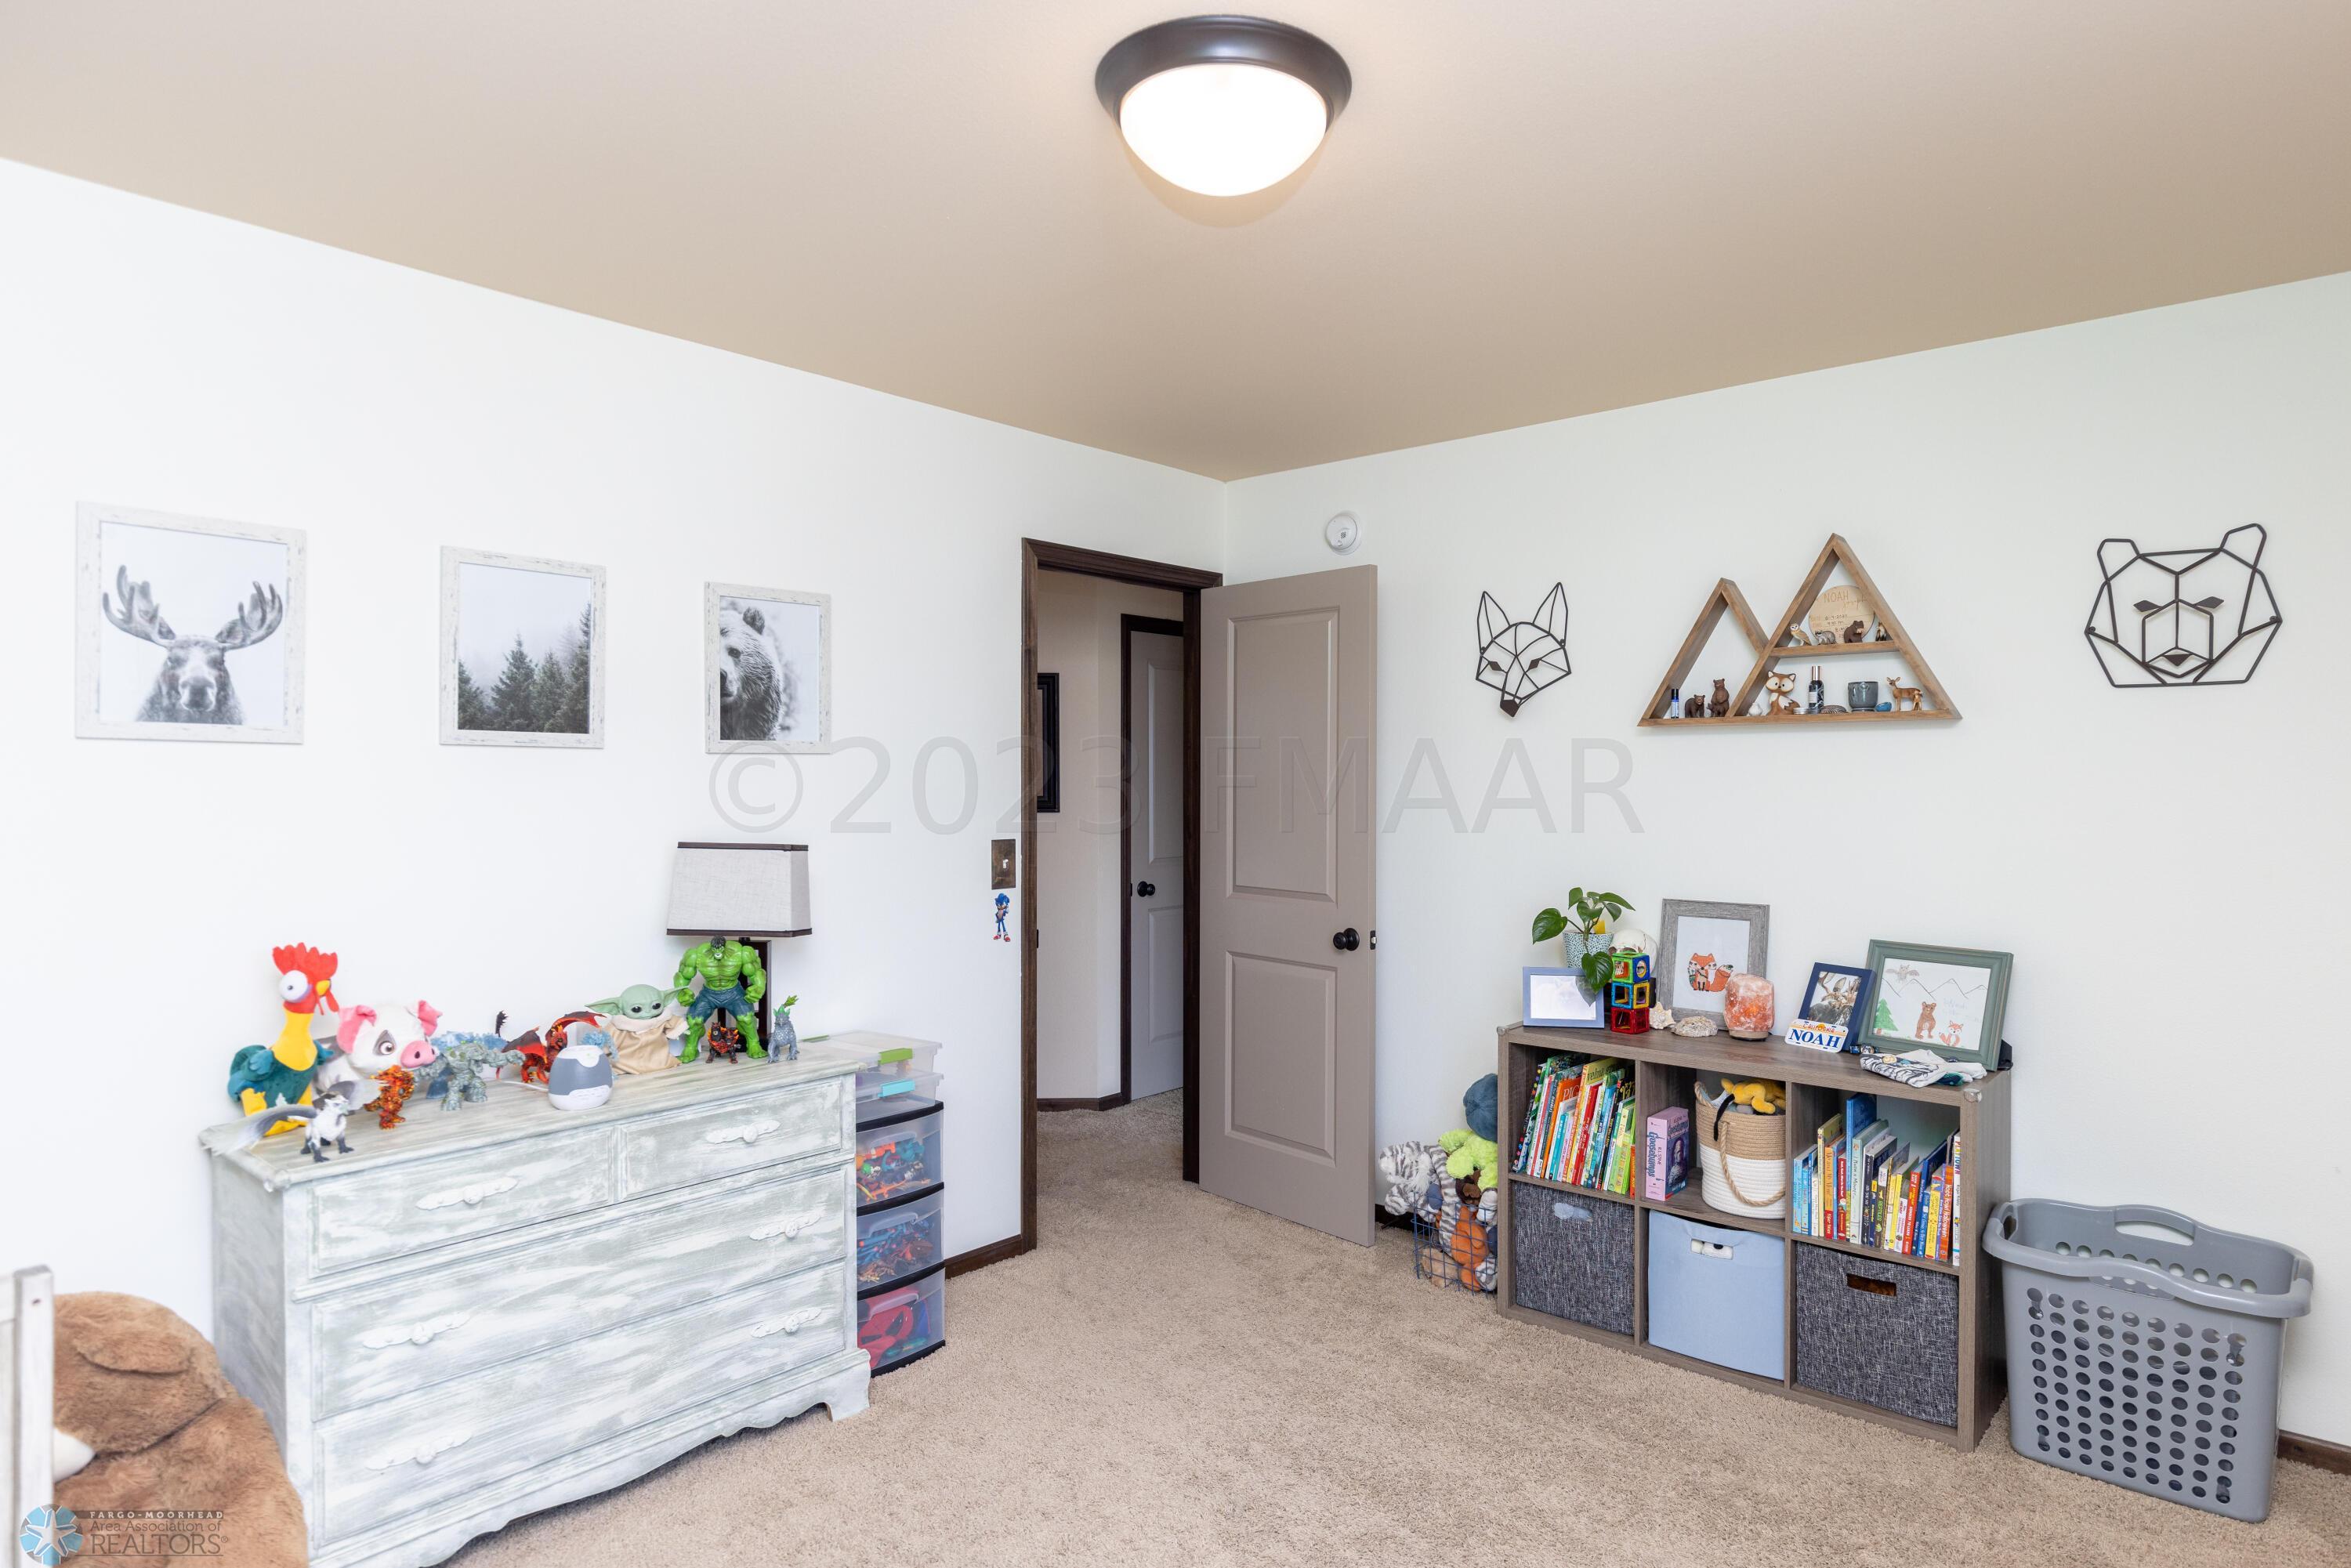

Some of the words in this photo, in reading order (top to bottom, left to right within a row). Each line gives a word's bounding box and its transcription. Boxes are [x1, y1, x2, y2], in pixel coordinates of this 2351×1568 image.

[1824, 590, 1849, 603] NOAH
[1802, 1023, 1835, 1033] CALIFORNIA
[1788, 1028, 1842, 1048] NOAH
[1646, 1132, 1660, 1178] Goosebumps
